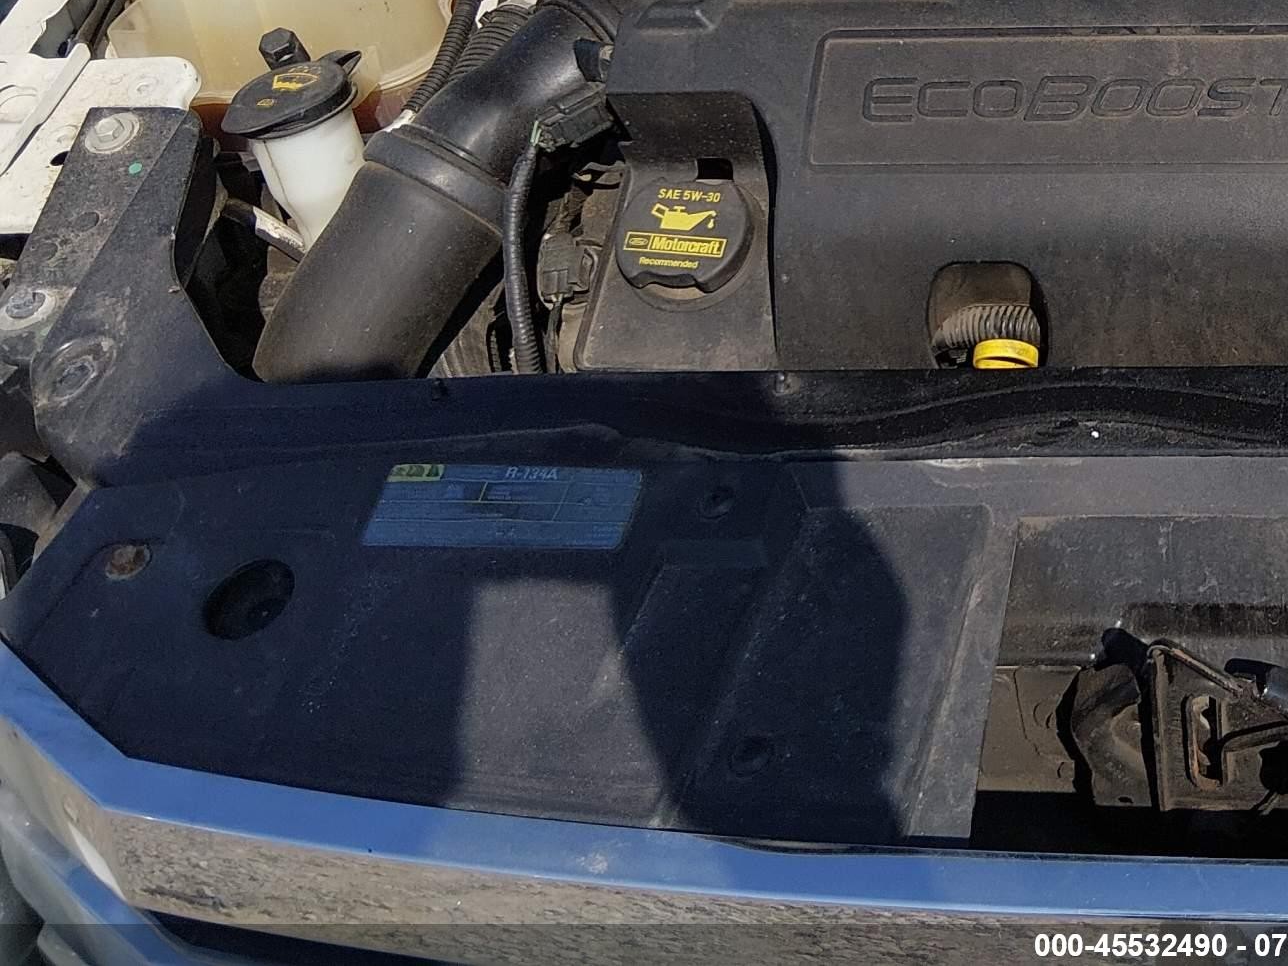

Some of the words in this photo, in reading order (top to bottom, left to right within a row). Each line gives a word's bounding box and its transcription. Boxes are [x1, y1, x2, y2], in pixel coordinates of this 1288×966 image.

[658, 188, 681, 200] SAE
[683, 190, 721, 202] 5W-30
[652, 236, 721, 254] Motorcraft
[639, 256, 699, 269] Recommended
